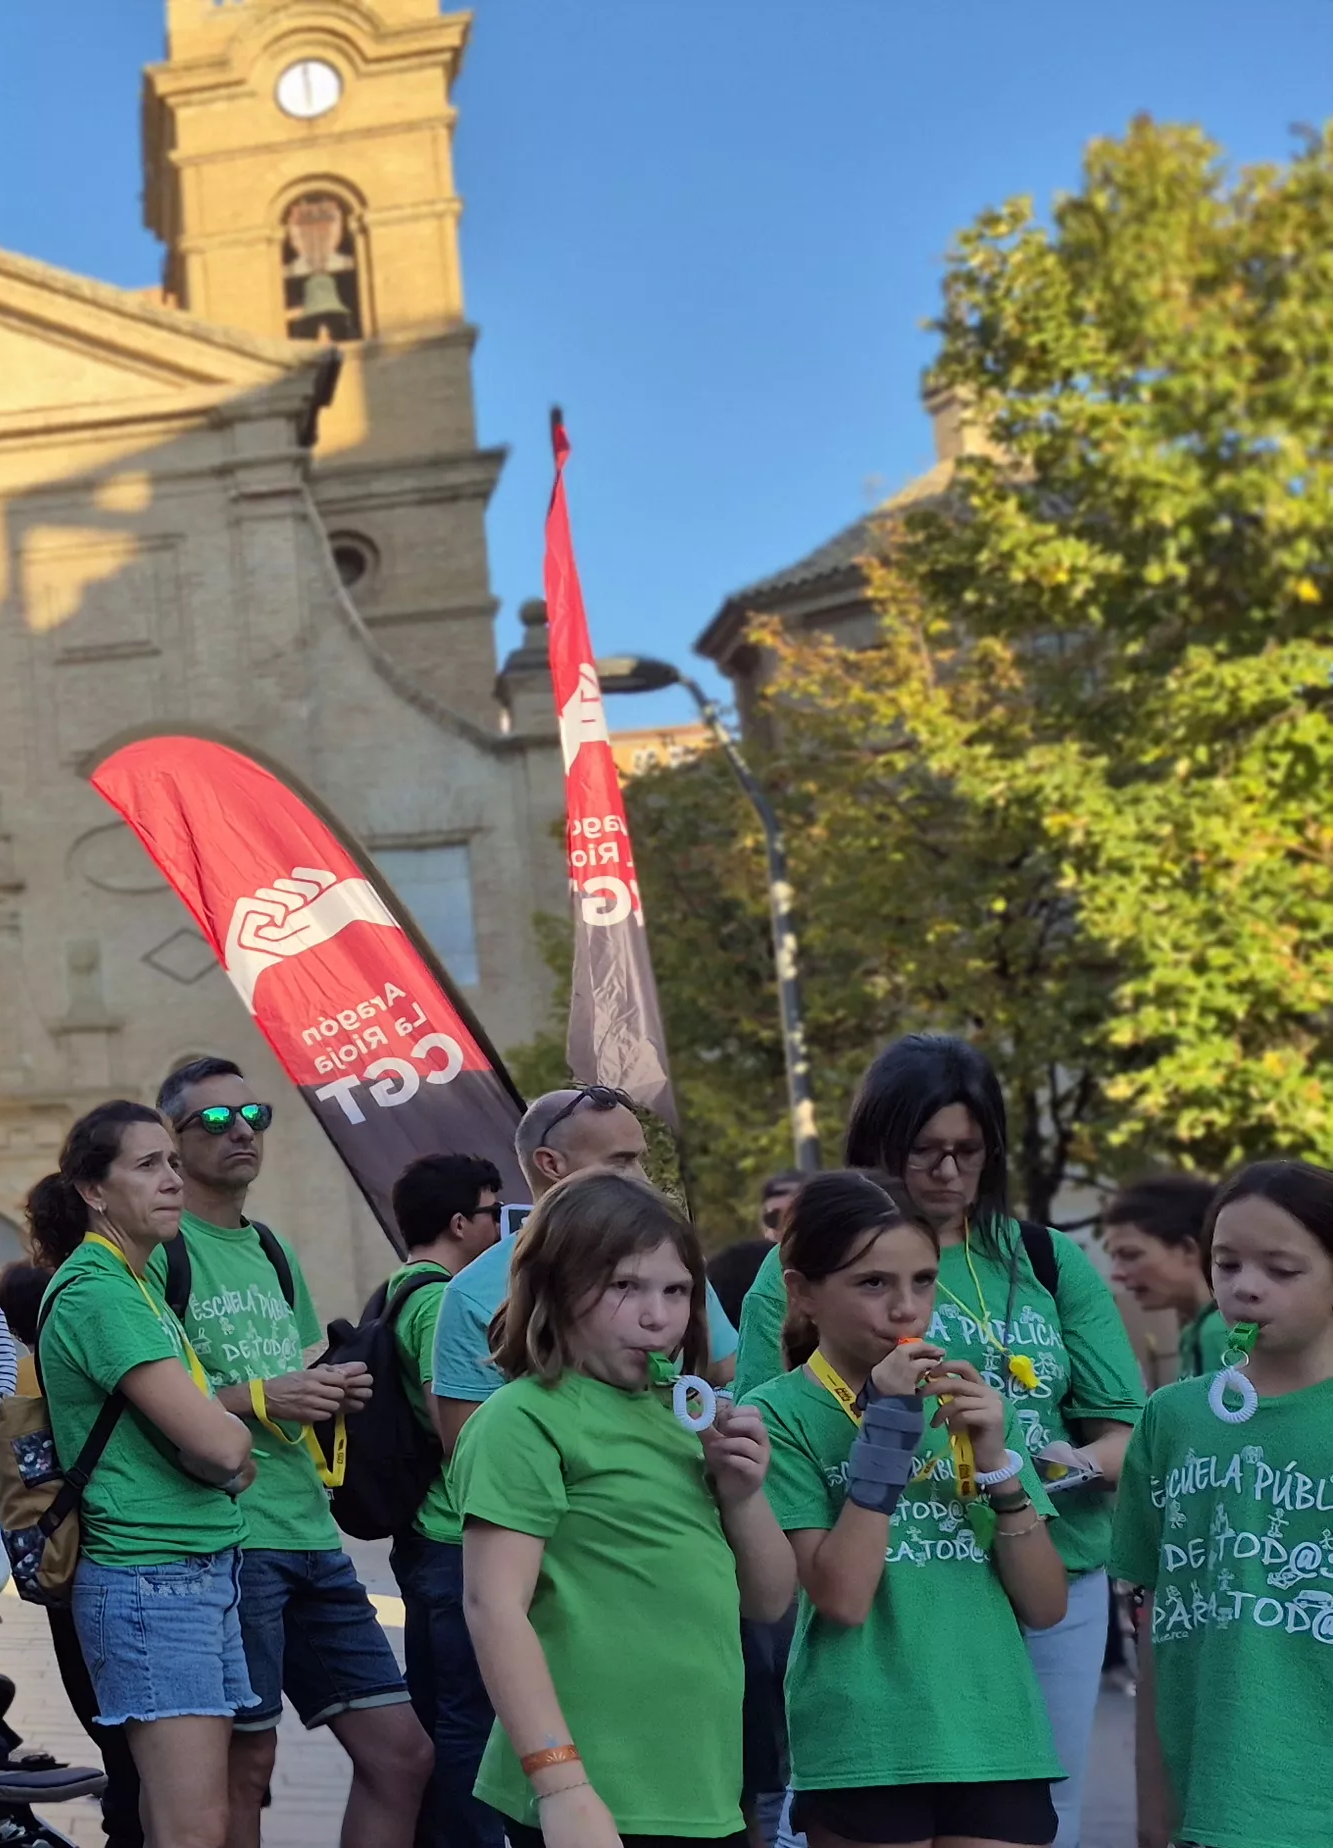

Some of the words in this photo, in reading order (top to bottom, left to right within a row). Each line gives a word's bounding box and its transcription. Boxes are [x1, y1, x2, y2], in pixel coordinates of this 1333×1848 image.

[192, 1289, 257, 1321] ESCUELA
[221, 1340, 251, 1362] DE
[251, 1337, 298, 1361] TOD@S
[1255, 1460, 1333, 1511] PÚBL
[1163, 1537, 1206, 1573] DE
[1151, 1591, 1218, 1634] PARA
[1227, 1590, 1333, 1645] TOD@
